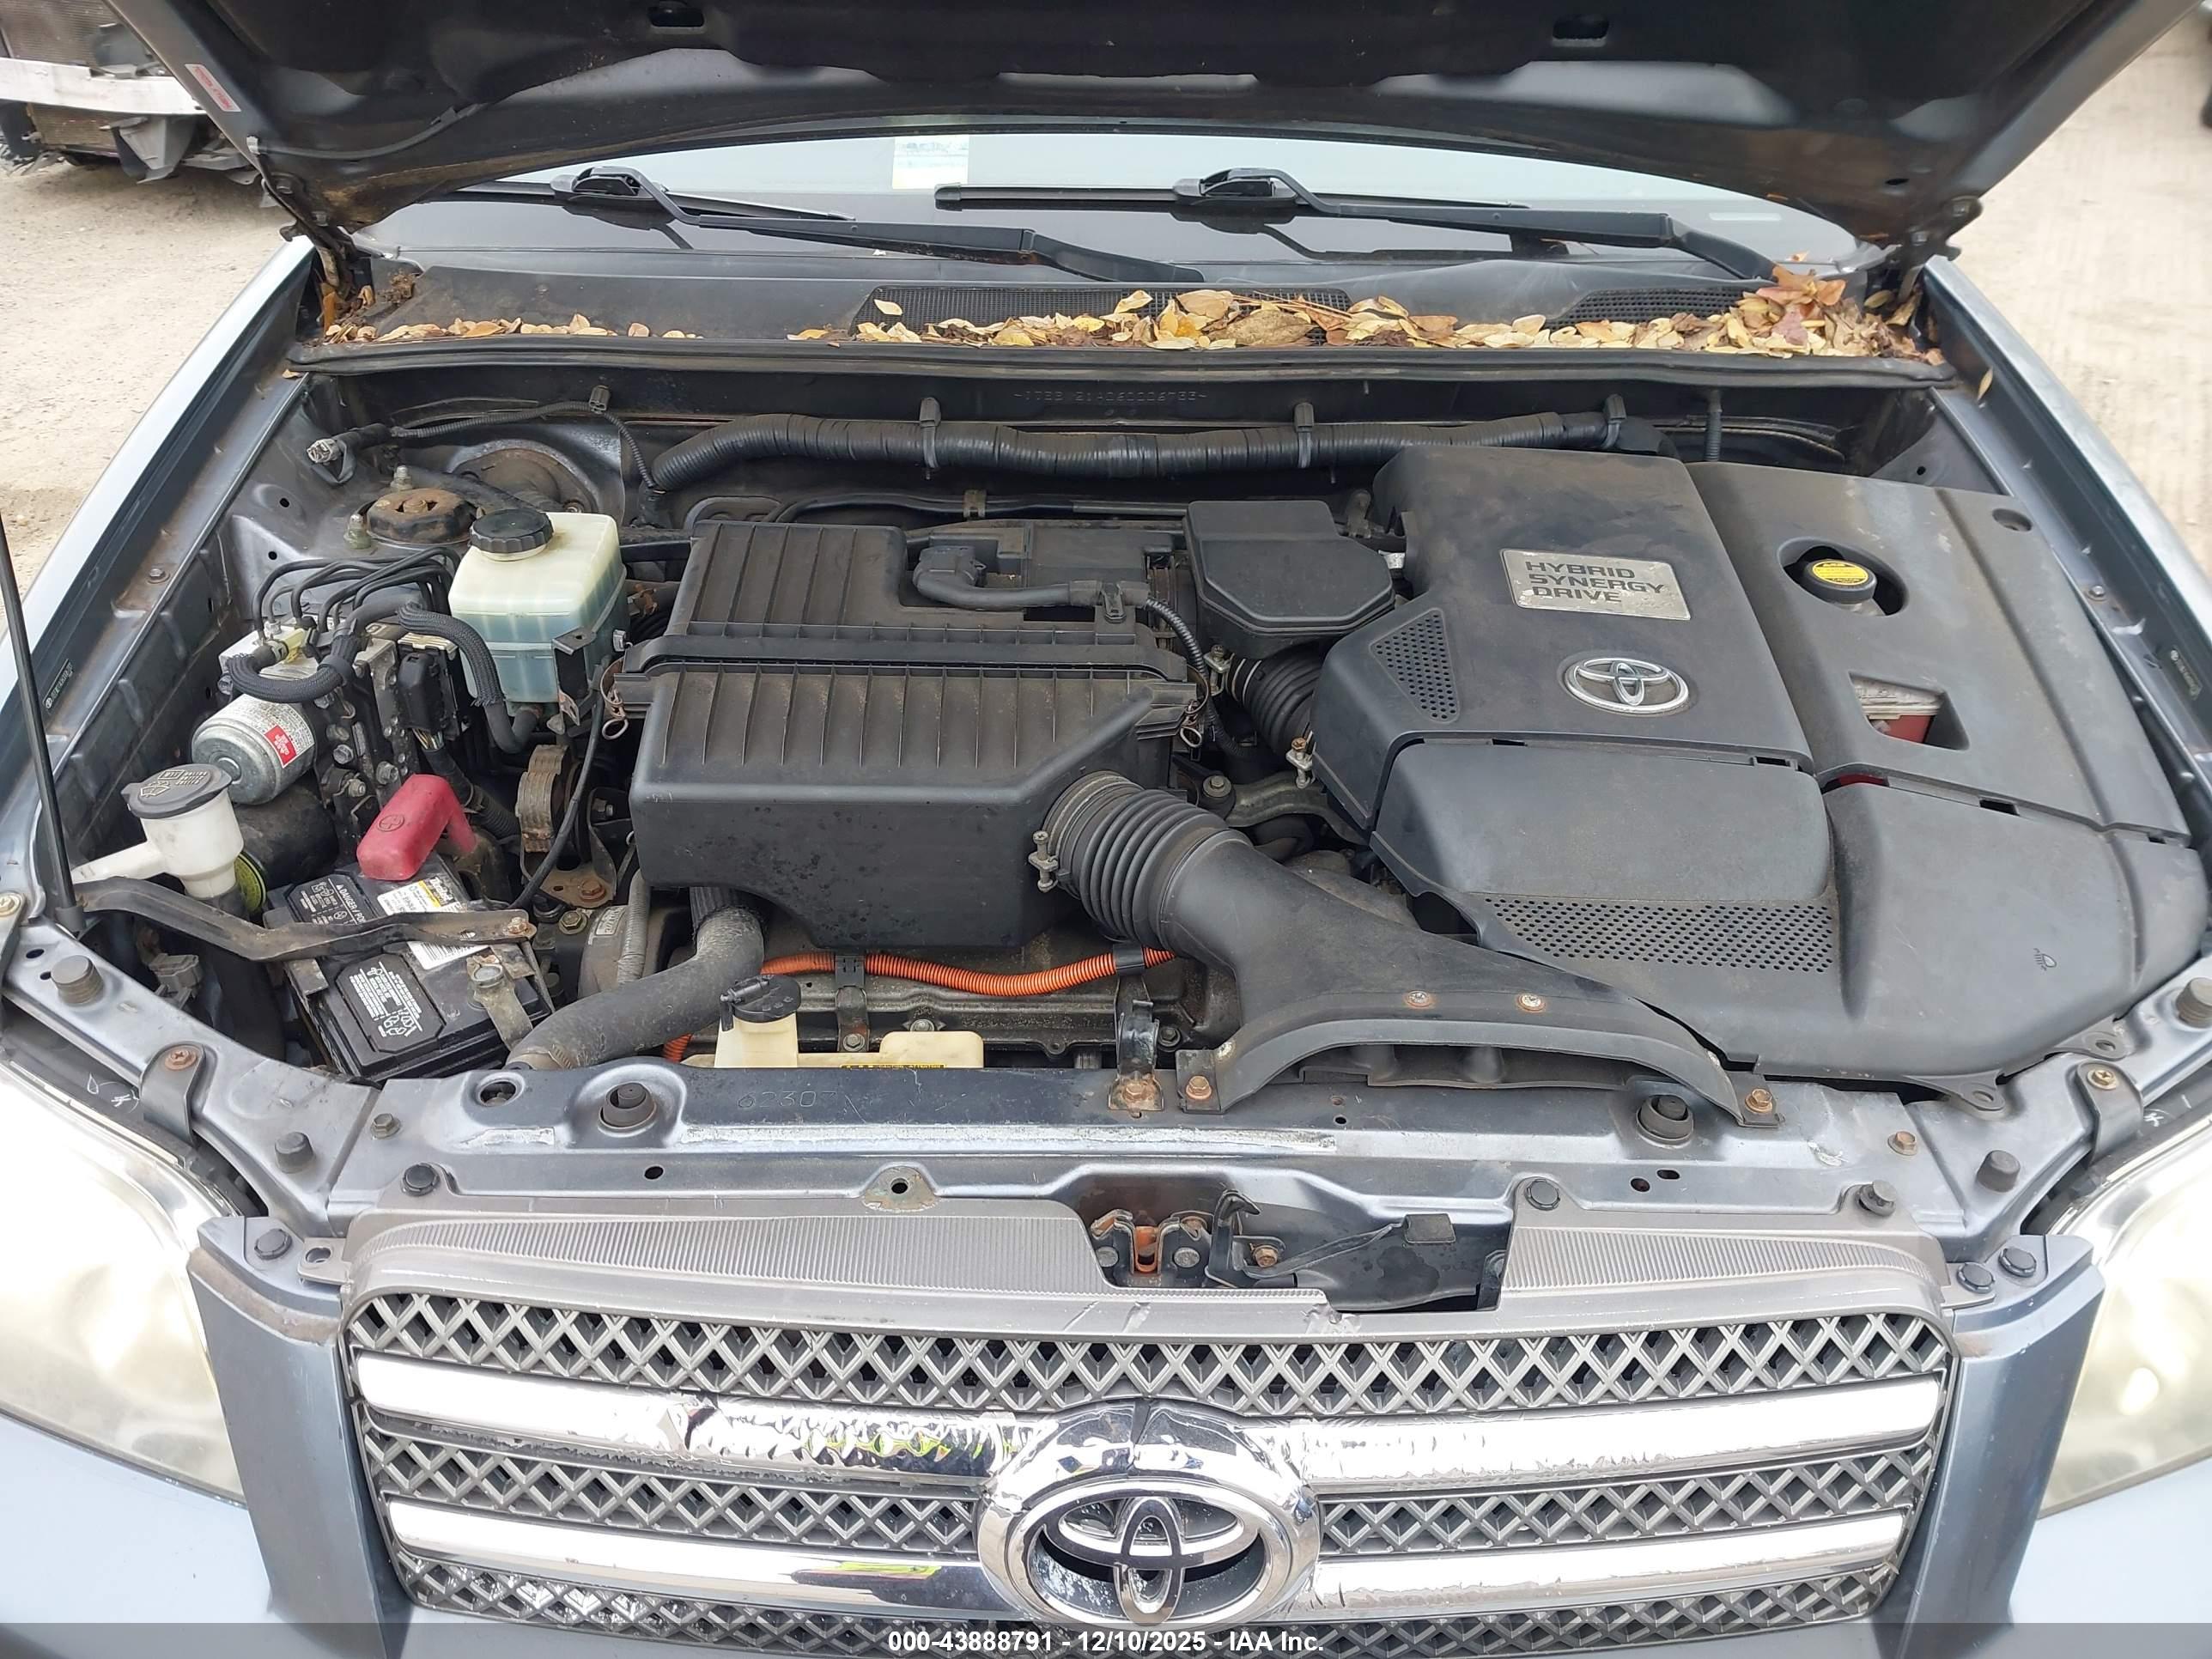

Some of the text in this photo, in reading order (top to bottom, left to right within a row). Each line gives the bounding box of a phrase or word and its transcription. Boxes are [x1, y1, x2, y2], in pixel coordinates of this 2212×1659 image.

[1525, 561, 1636, 579] HYBRID
[1528, 573, 1665, 594] SYNERGY
[1531, 586, 1622, 603] DRIVE
[339, 888, 358, 911] DANGER
